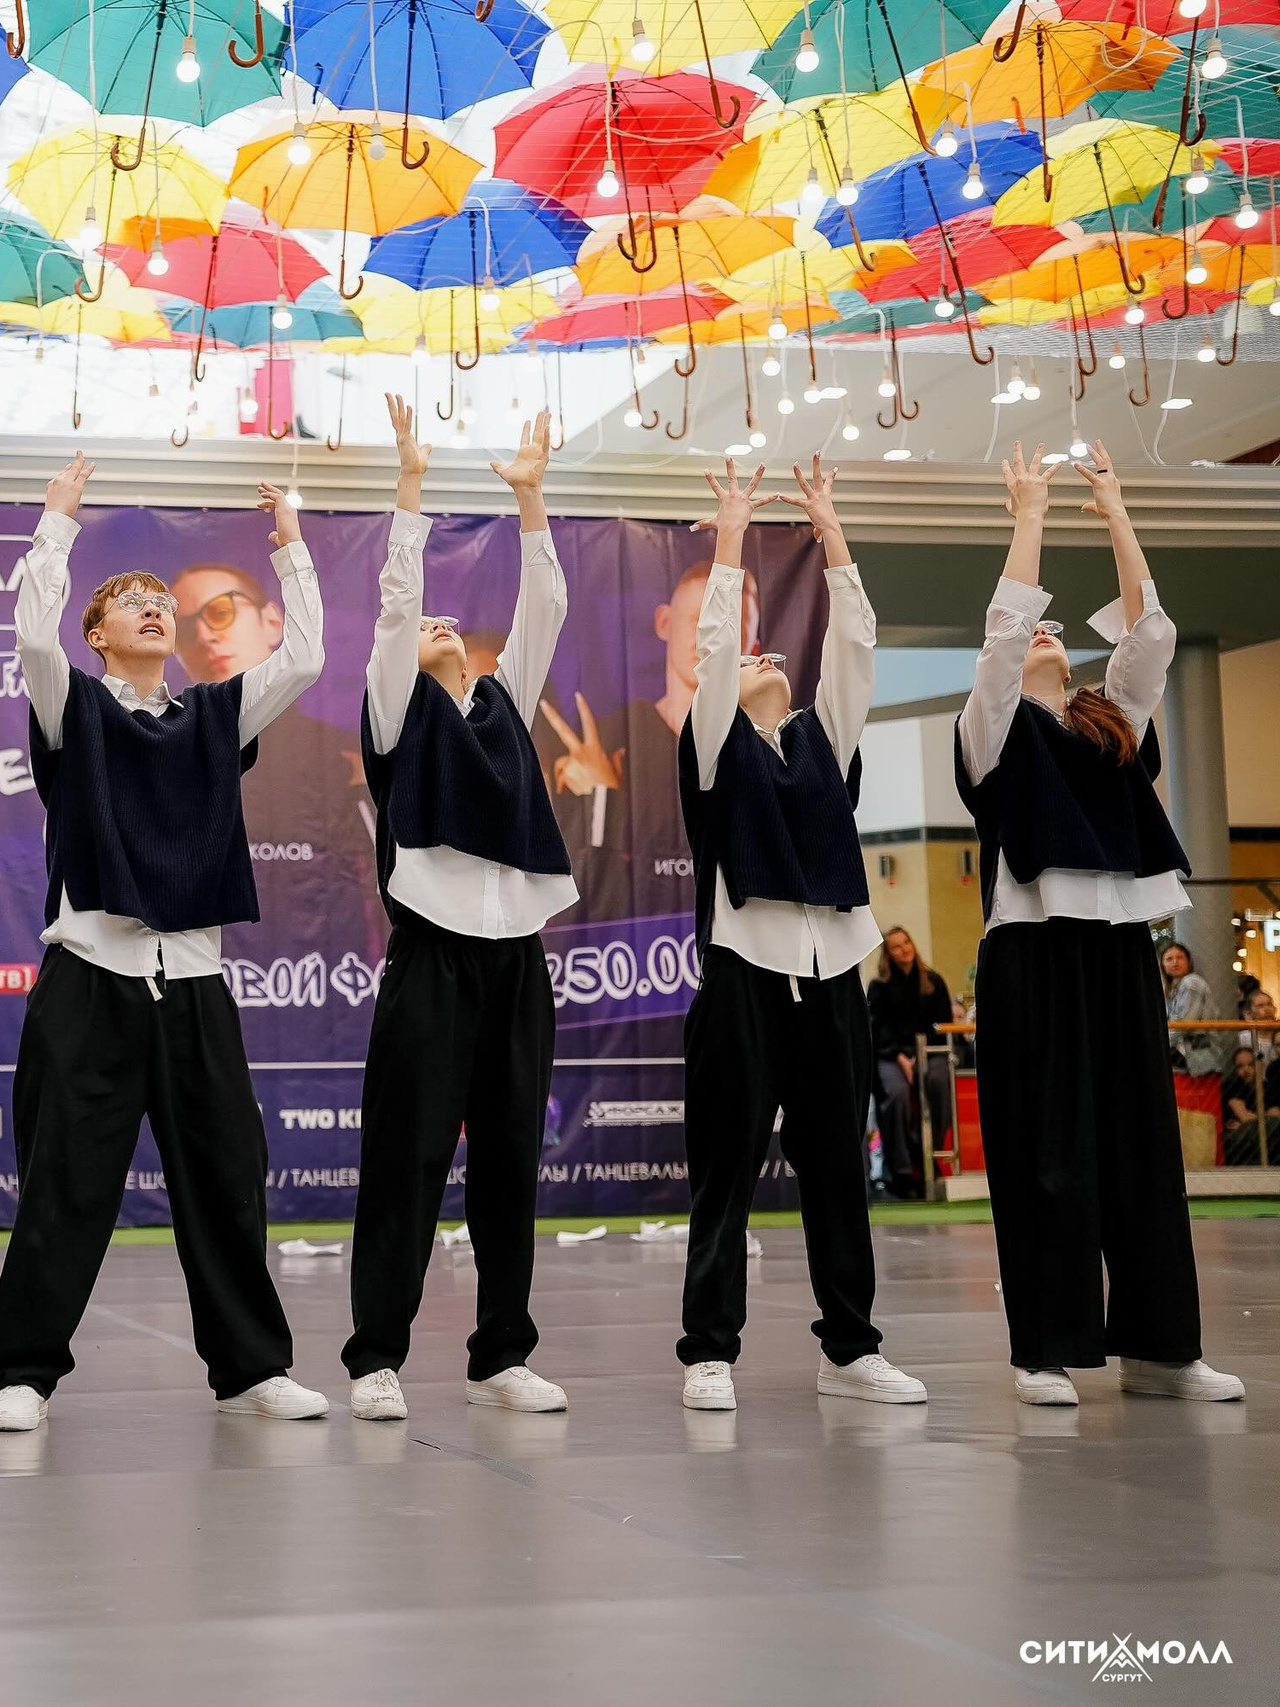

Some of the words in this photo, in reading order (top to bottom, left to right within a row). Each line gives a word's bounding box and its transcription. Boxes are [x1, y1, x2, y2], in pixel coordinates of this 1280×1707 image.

[249, 842, 314, 860] КОЛОВ
[654, 858, 694, 876] ИГО
[280, 1109, 335, 1130] TWO
[290, 1168, 359, 1187] ТАНЦЕВ
[583, 1161, 689, 1182] ТАНЦЕВАЛЬ
